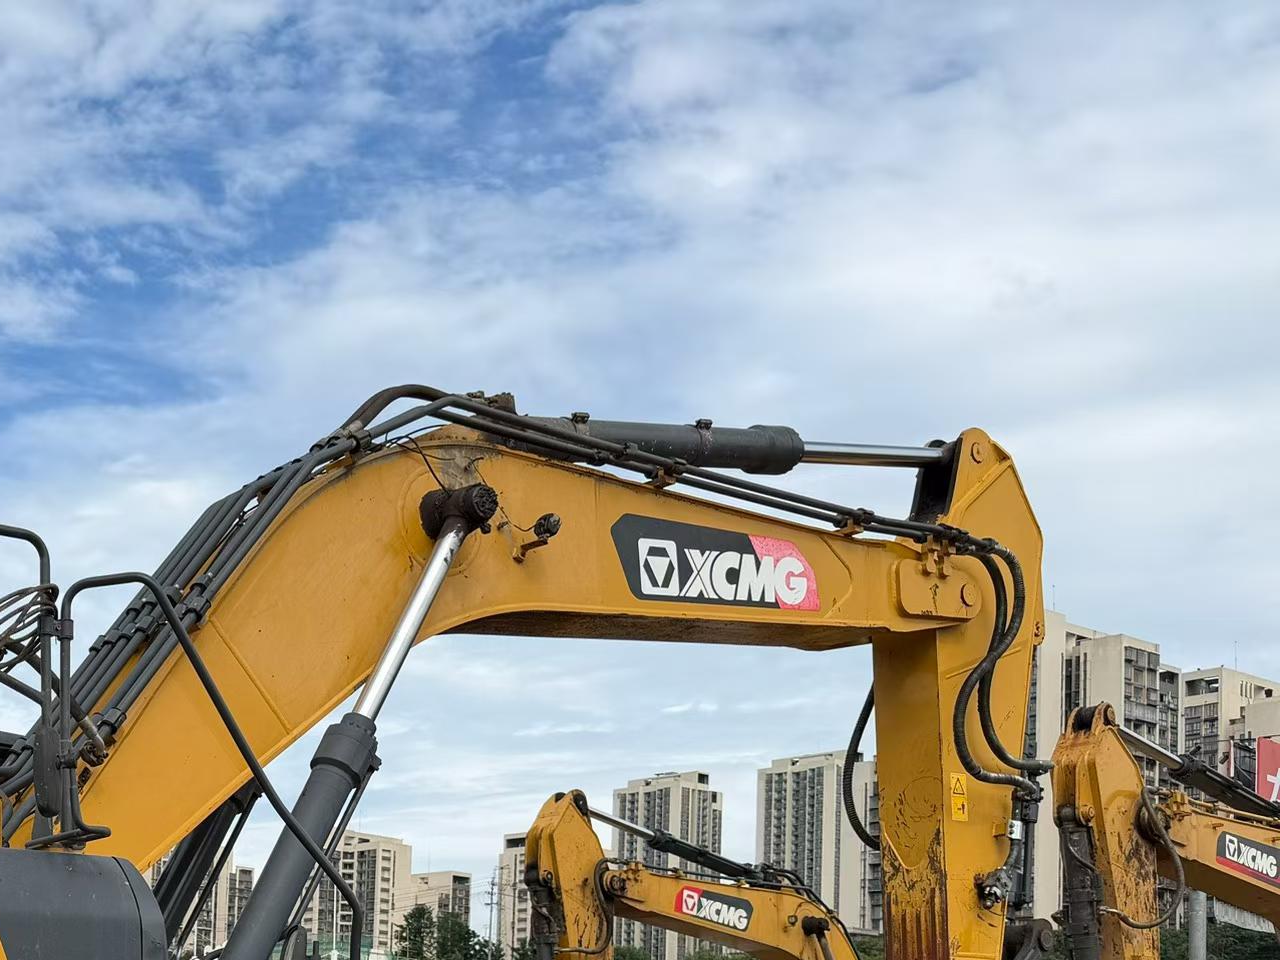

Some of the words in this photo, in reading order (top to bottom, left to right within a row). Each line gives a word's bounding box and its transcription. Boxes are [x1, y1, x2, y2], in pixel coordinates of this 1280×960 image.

[679, 548, 808, 606] XCMG
[1238, 842, 1278, 878] XCMG
[697, 897, 748, 930] XCMG
